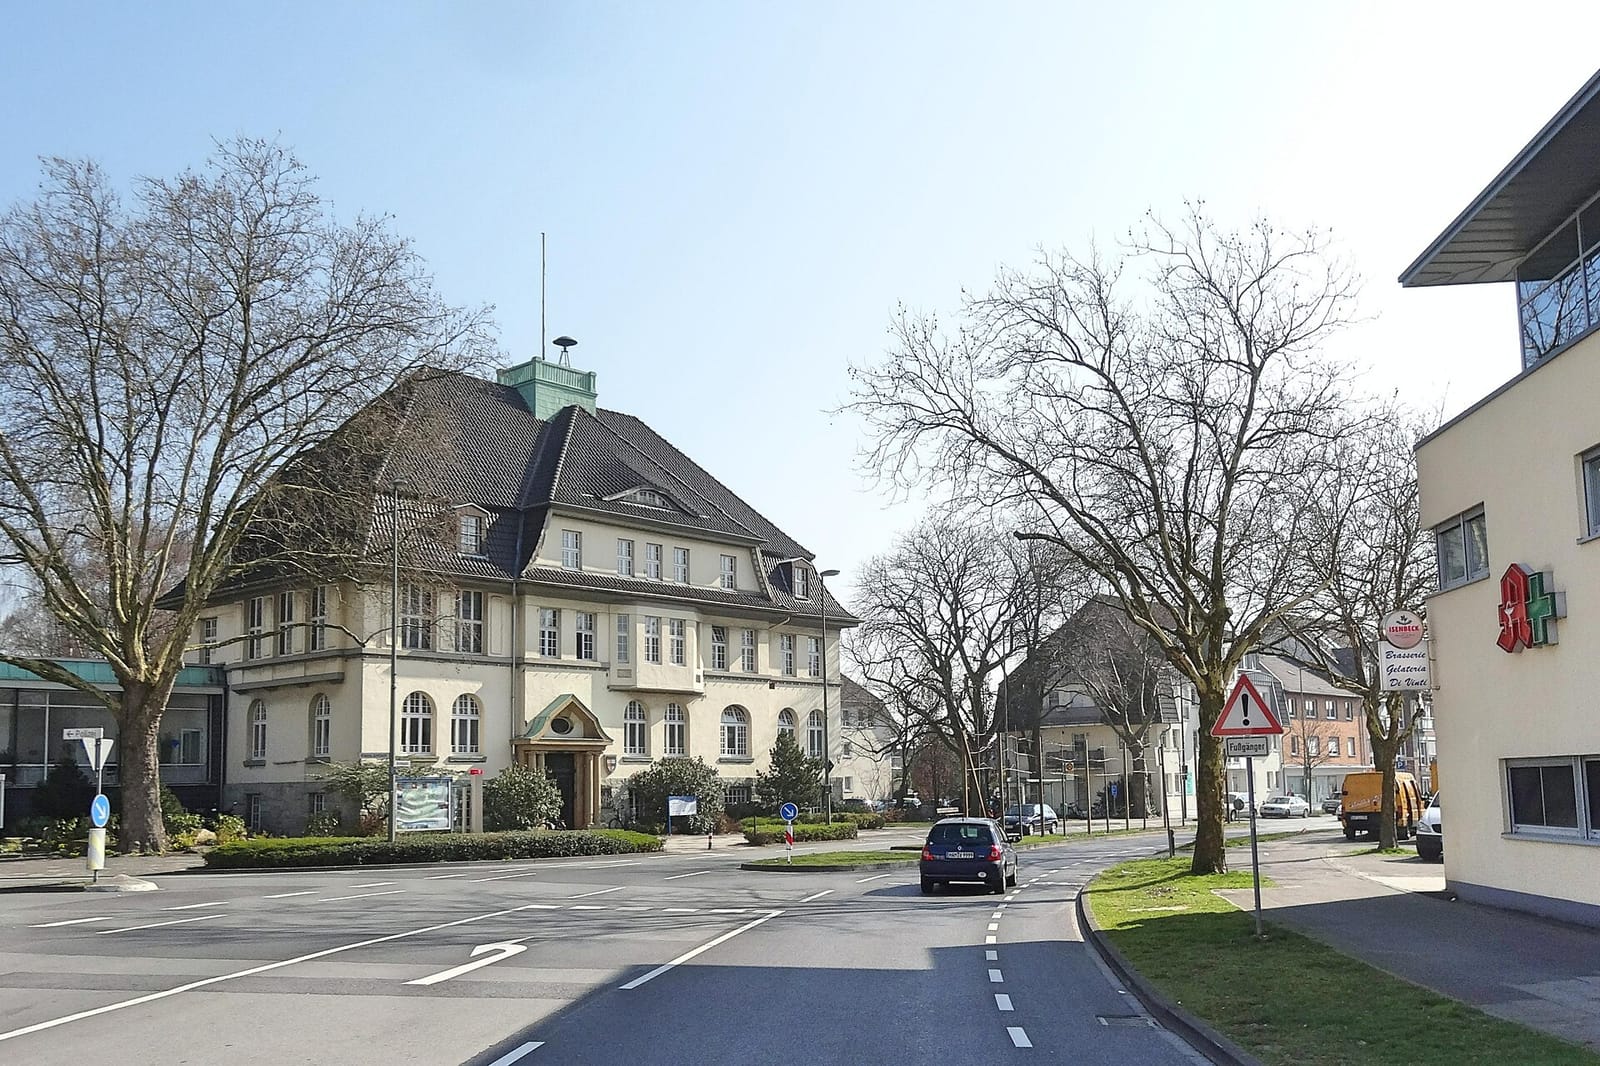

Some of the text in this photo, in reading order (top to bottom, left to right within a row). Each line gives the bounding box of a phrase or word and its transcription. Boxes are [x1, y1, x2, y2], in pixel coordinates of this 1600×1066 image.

[1388, 625, 1420, 633] ISENBECK
[1385, 650, 1426, 659] Brasserie
[1386, 664, 1426, 676] Gelateria
[1389, 678, 1401, 687] Di
[1229, 742, 1266, 753] Fußgänger
